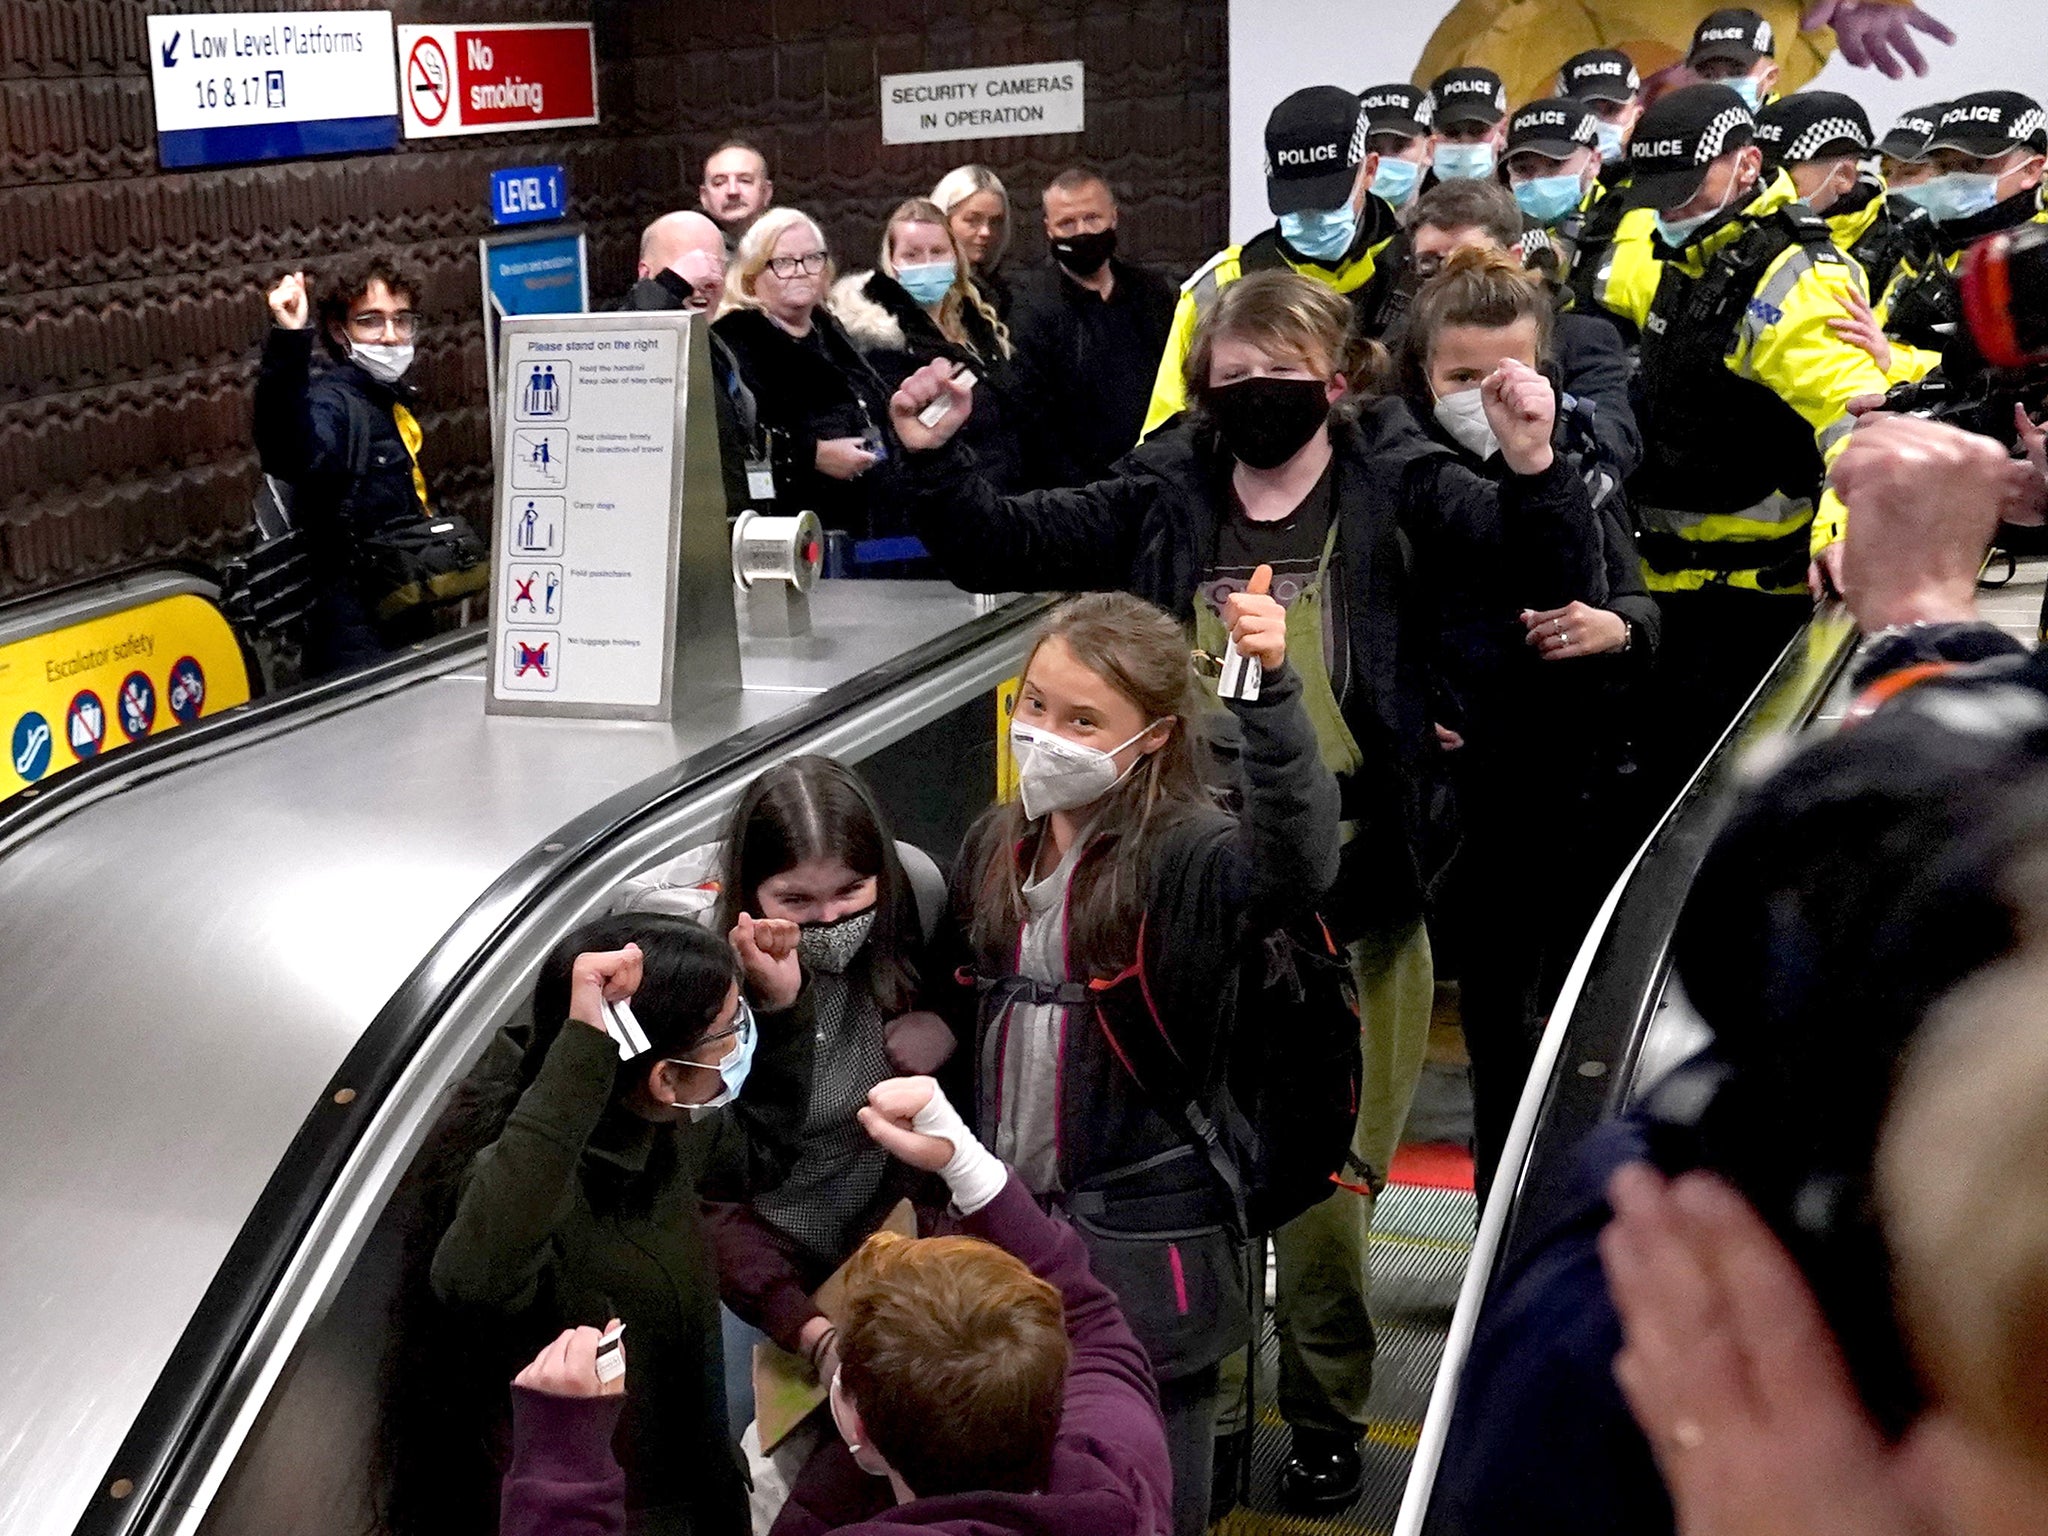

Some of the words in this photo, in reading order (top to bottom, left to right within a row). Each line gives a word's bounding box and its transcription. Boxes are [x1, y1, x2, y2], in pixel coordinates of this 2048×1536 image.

[190, 28, 228, 59] Low
[233, 26, 279, 57] Level
[283, 24, 363, 54] Platforms
[1701, 27, 1744, 41] POLICE
[466, 37, 494, 71] No
[1573, 61, 1622, 79] POLICE
[196, 79, 217, 109] 16
[223, 77, 236, 107] &
[242, 76, 260, 106] 17
[470, 76, 544, 114] smoking
[892, 83, 978, 104] SECURITY
[985, 75, 1073, 97] CAMERAS
[1444, 80, 1492, 97] POLICE
[1360, 94, 1410, 109] POLICE
[921, 114, 937, 129] IN
[945, 106, 1043, 127] OPERATION
[1514, 110, 1567, 131] POLICE
[1940, 106, 2002, 128] POLICE
[1278, 144, 1338, 166] POLICE
[1631, 140, 1683, 158] POLICE
[500, 177, 546, 214] LEVEL
[548, 176, 558, 208] 1
[528, 342, 562, 351] Please
[566, 341, 594, 351] stand
[597, 341, 611, 351] on
[614, 340, 630, 349] the
[634, 339, 658, 352] right
[46, 649, 108, 682] Escalator
[113, 634, 154, 661] safety
